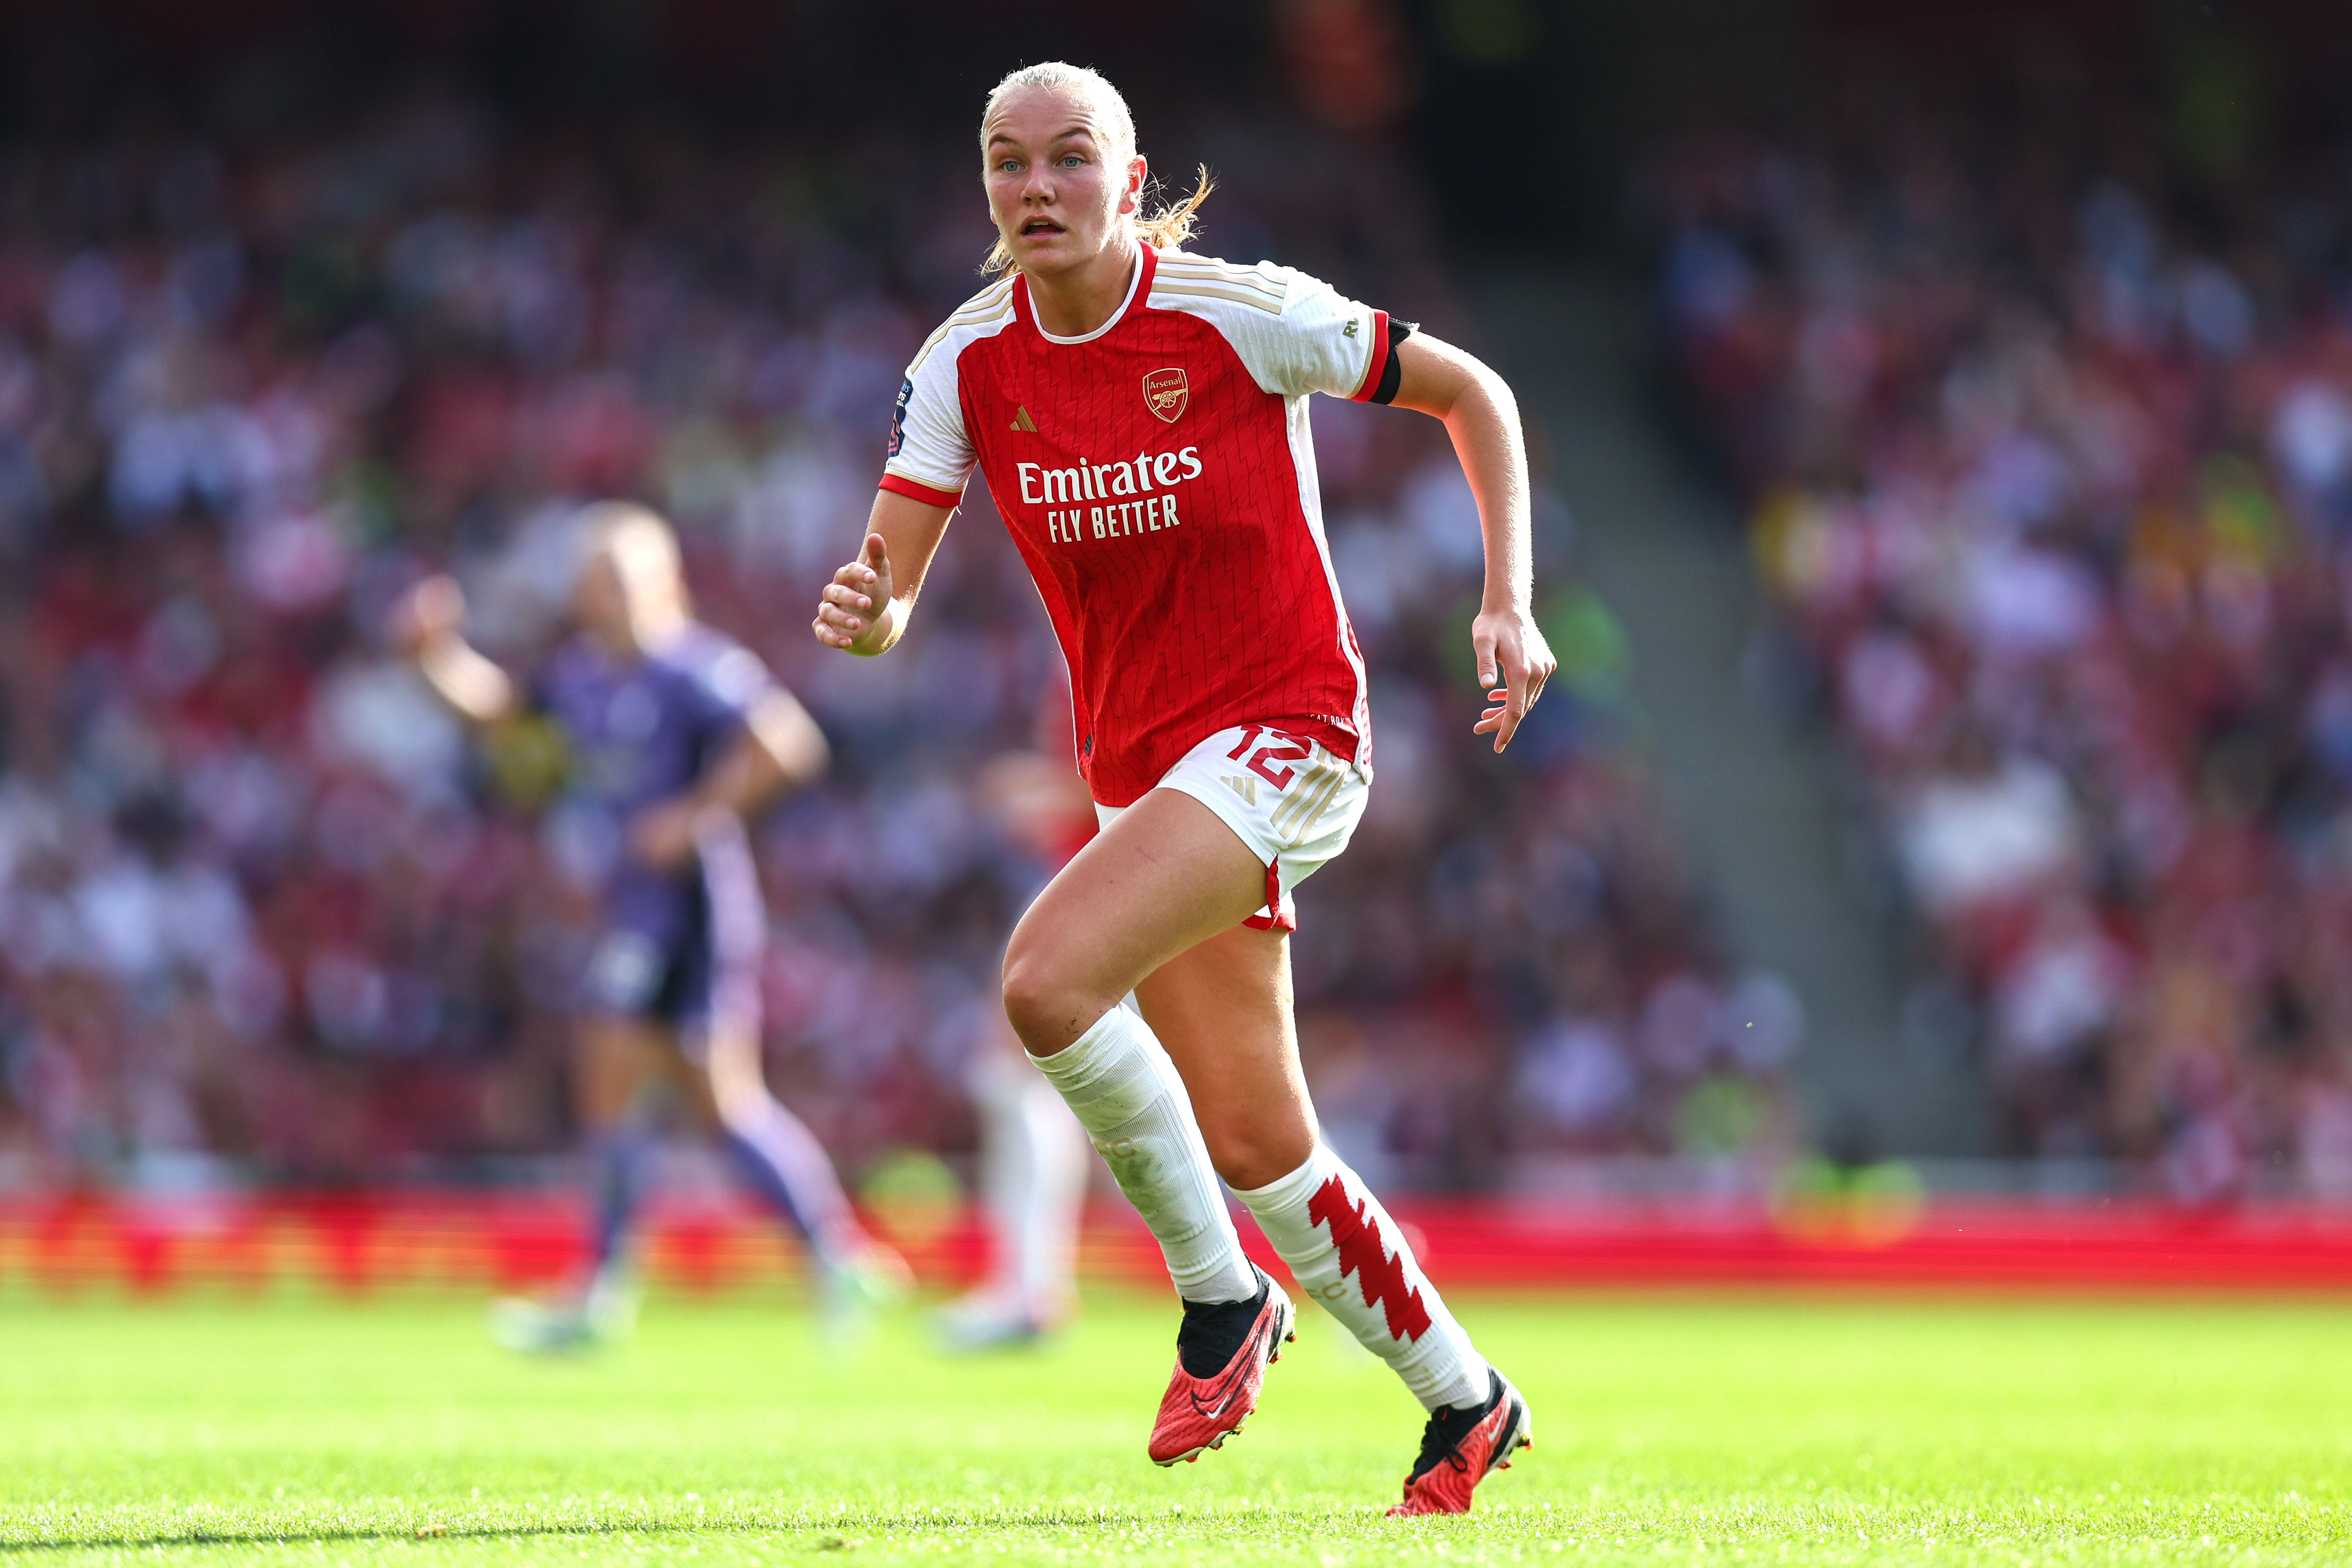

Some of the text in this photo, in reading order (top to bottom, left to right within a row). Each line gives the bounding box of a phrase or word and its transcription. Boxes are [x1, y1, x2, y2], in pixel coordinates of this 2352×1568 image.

[1150, 376, 1181, 389] Arsenal
[1016, 446, 1202, 504] Emirates
[1048, 494, 1180, 543] FLY BETTER
[1226, 725, 1313, 792] 12
